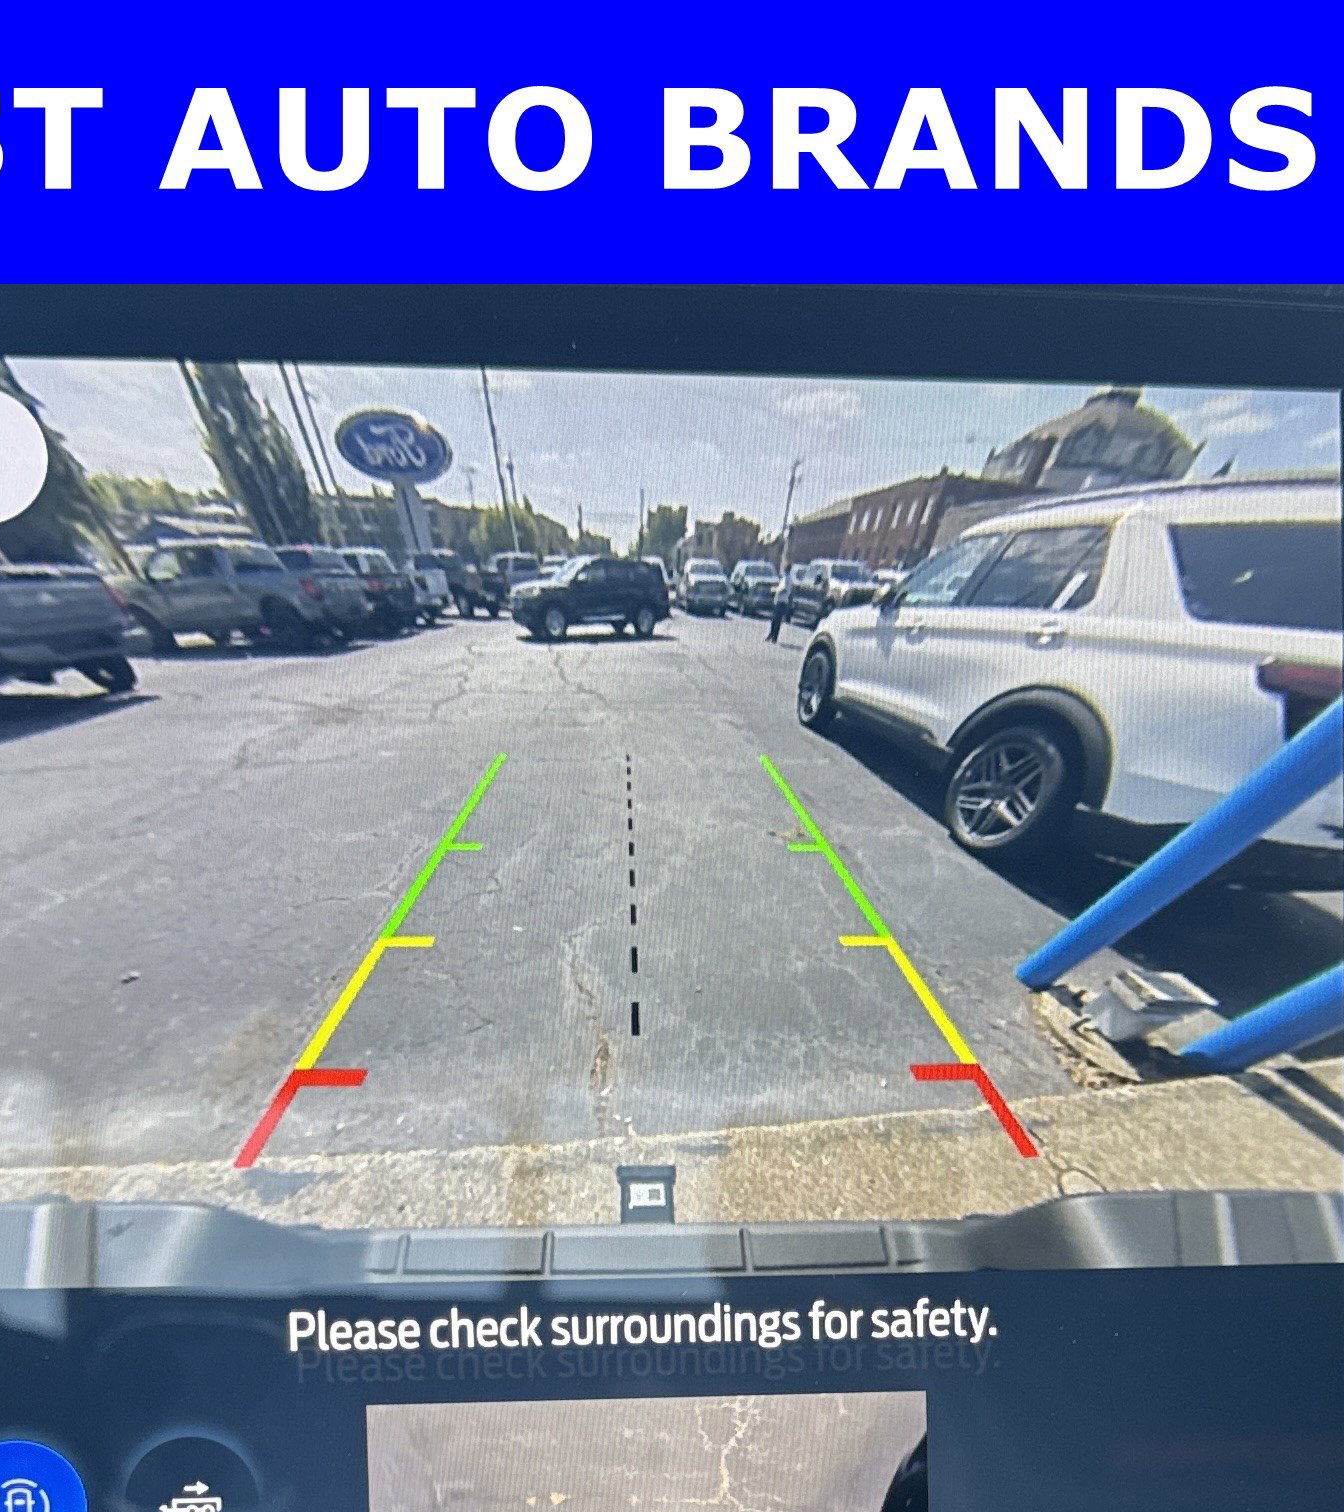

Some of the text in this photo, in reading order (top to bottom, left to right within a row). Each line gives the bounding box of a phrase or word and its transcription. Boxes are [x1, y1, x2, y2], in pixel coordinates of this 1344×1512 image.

[288, 1297, 998, 1352] Please check surroundings for safety.
